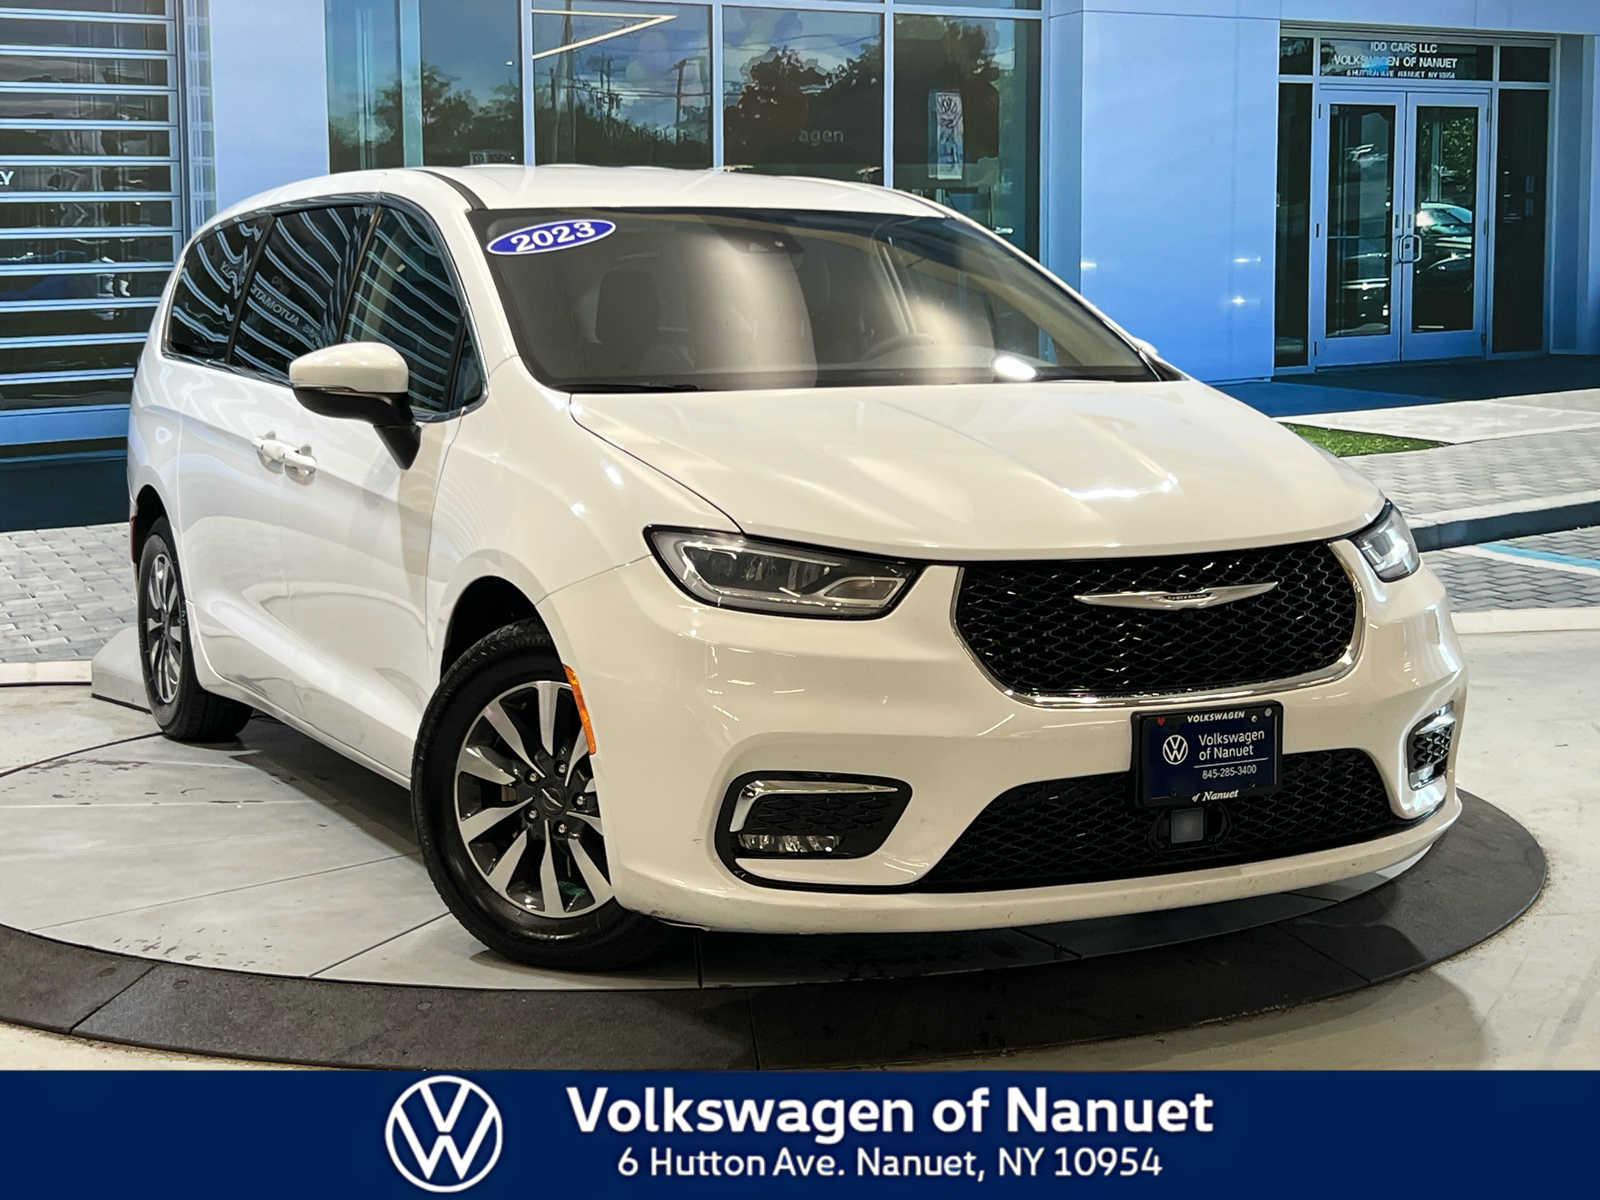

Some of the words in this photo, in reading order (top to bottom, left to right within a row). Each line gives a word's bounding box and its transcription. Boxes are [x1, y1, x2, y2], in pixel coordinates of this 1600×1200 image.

[1390, 43, 1417, 54] CARS
[1419, 43, 1438, 54] LLC
[1403, 57, 1417, 67] OF
[1418, 57, 1458, 69] NANUET
[510, 221, 596, 252] 2023
[1187, 711, 1246, 723] VOLKSWAGEN
[1198, 730, 1265, 746] Volkswagen
[1199, 747, 1212, 760] of
[1213, 745, 1254, 759] Nanuet
[1202, 764, 1257, 780] 845-285-3400
[1201, 789, 1239, 802] Nanuet
